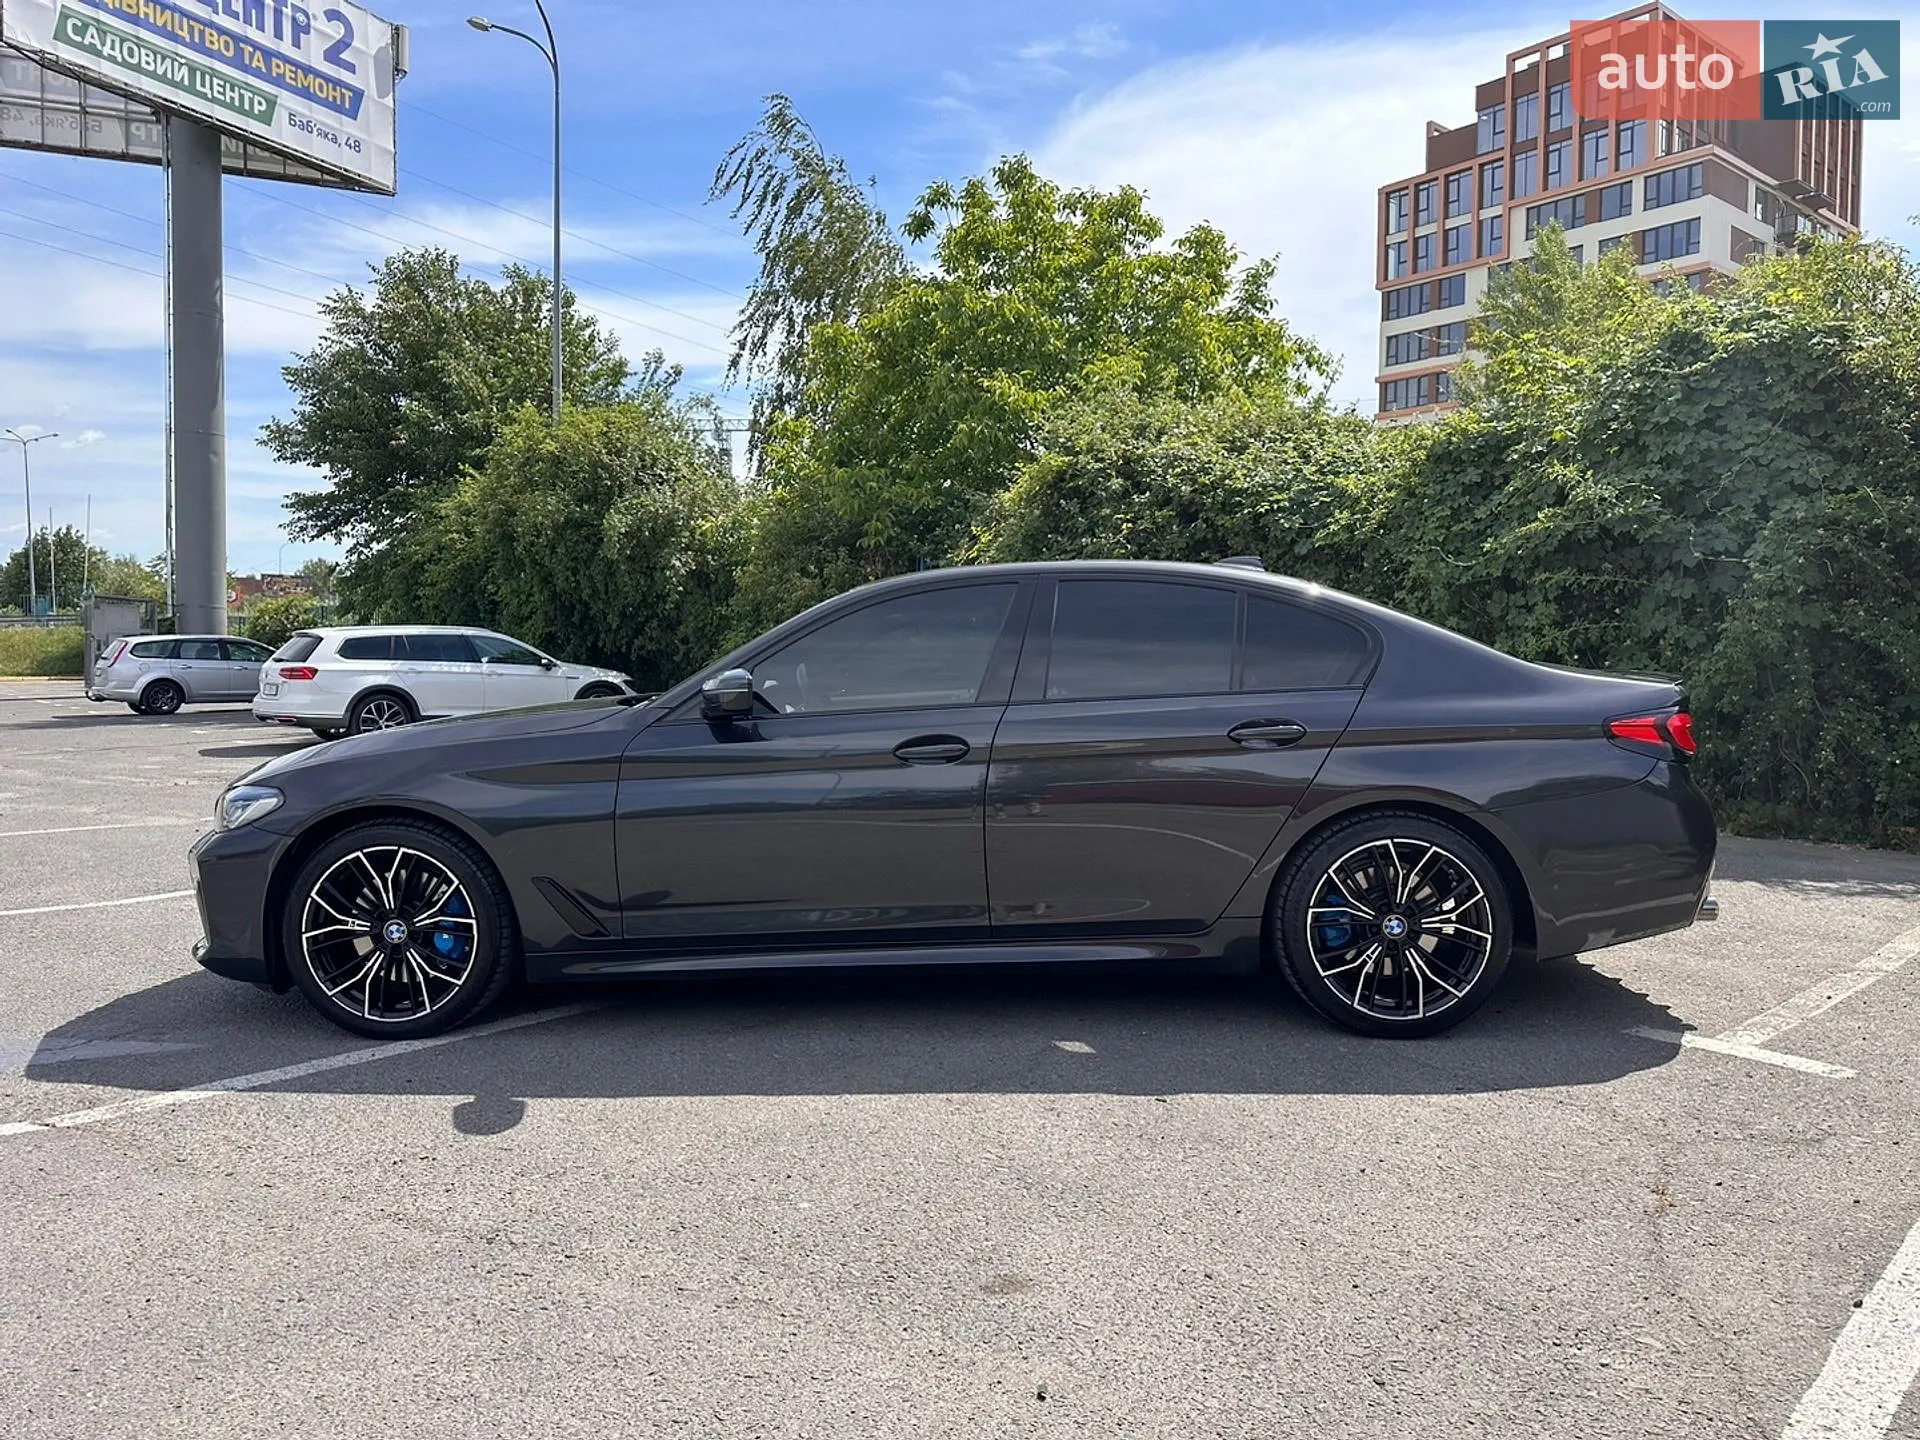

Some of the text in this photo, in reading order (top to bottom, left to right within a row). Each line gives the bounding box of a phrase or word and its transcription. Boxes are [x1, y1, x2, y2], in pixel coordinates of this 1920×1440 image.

[65, 17, 190, 86] САДОВИЙ
[195, 71, 269, 116] ЦЕНТР
[323, 8, 356, 75] 2
[240, 42, 267, 72] ТА
[271, 57, 353, 109] РЕМОНТ
[287, 112, 342, 148] Баб'яка,
[345, 137, 362, 154] 48
